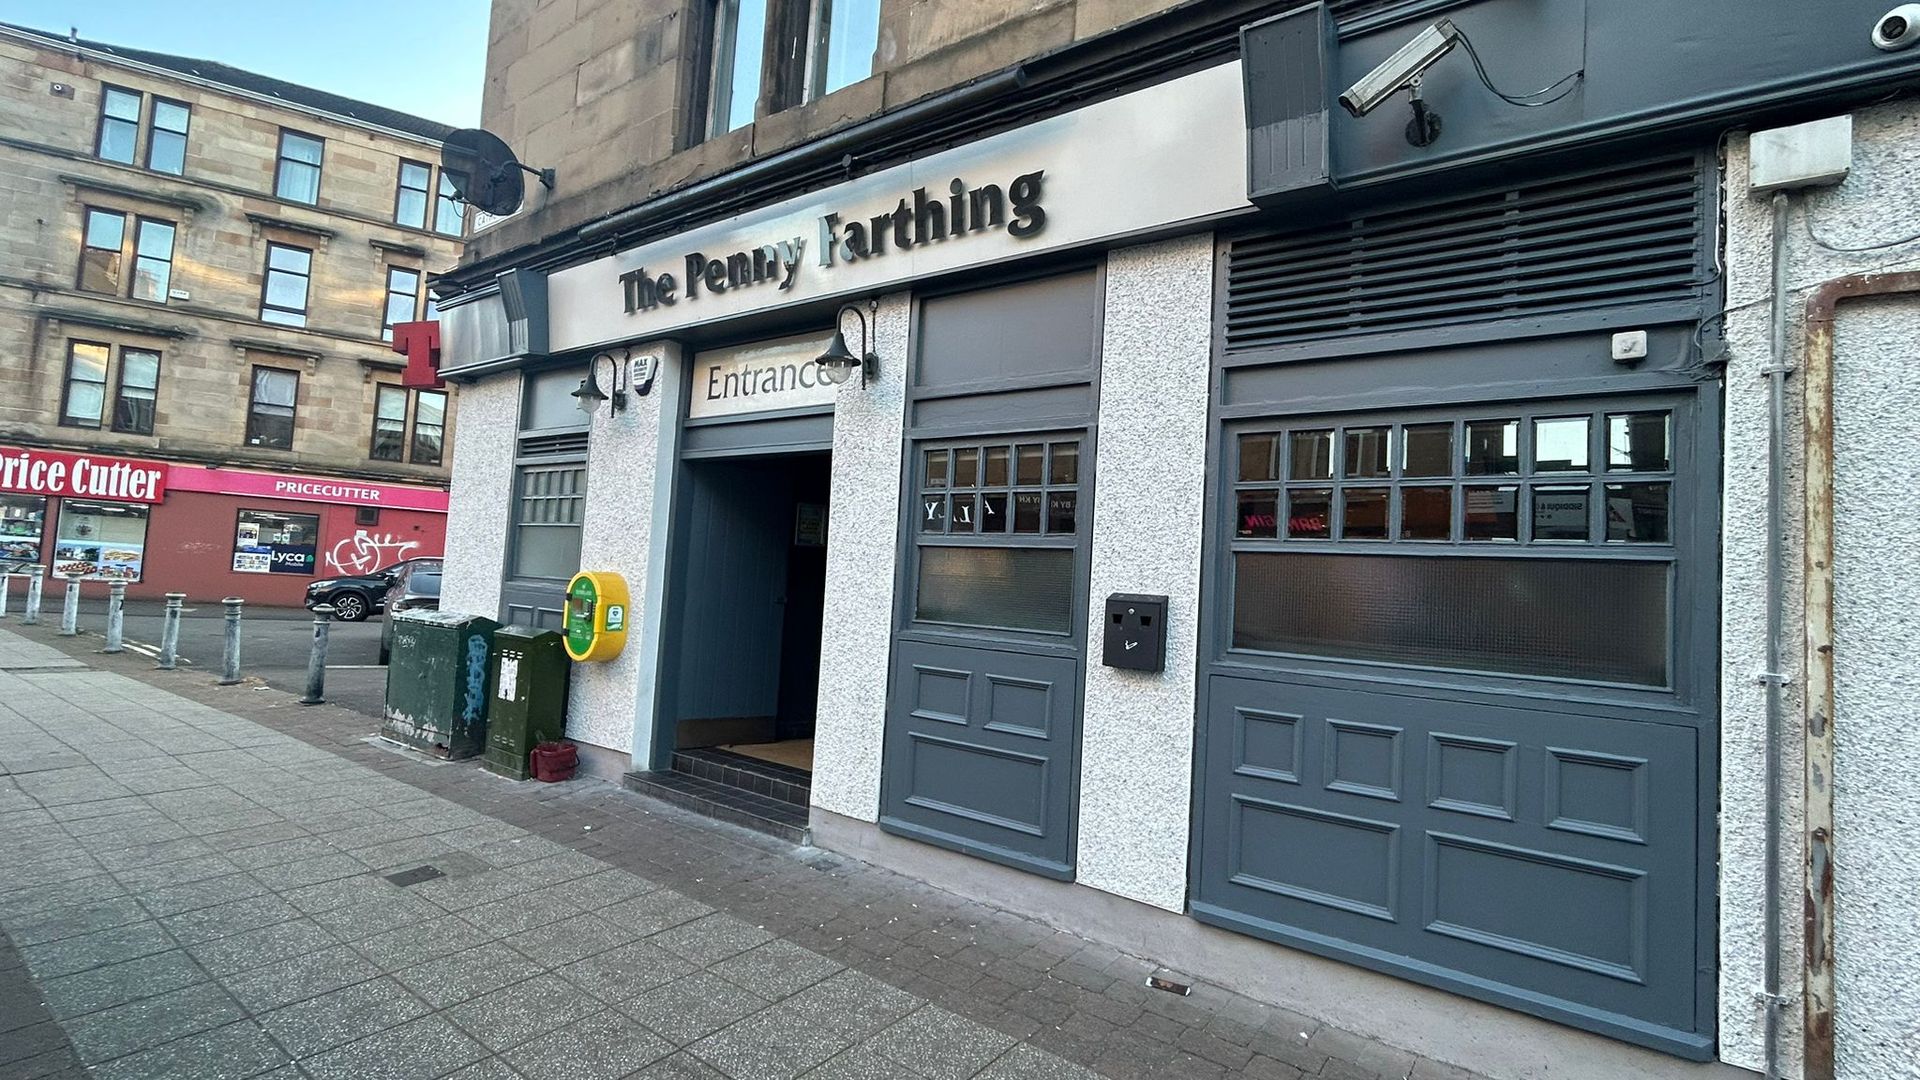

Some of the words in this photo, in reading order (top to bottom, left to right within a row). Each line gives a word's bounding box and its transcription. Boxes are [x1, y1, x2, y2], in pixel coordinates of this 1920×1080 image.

[618, 267, 676, 314] The
[684, 236, 803, 298] Penny
[818, 170, 1045, 266] Farthing
[707, 360, 832, 400] Entrance
[0, 453, 66, 491] rice
[71, 458, 161, 499] Cutter
[275, 481, 380, 500] PRICECUTTER
[271, 550, 305, 563] Lyca
